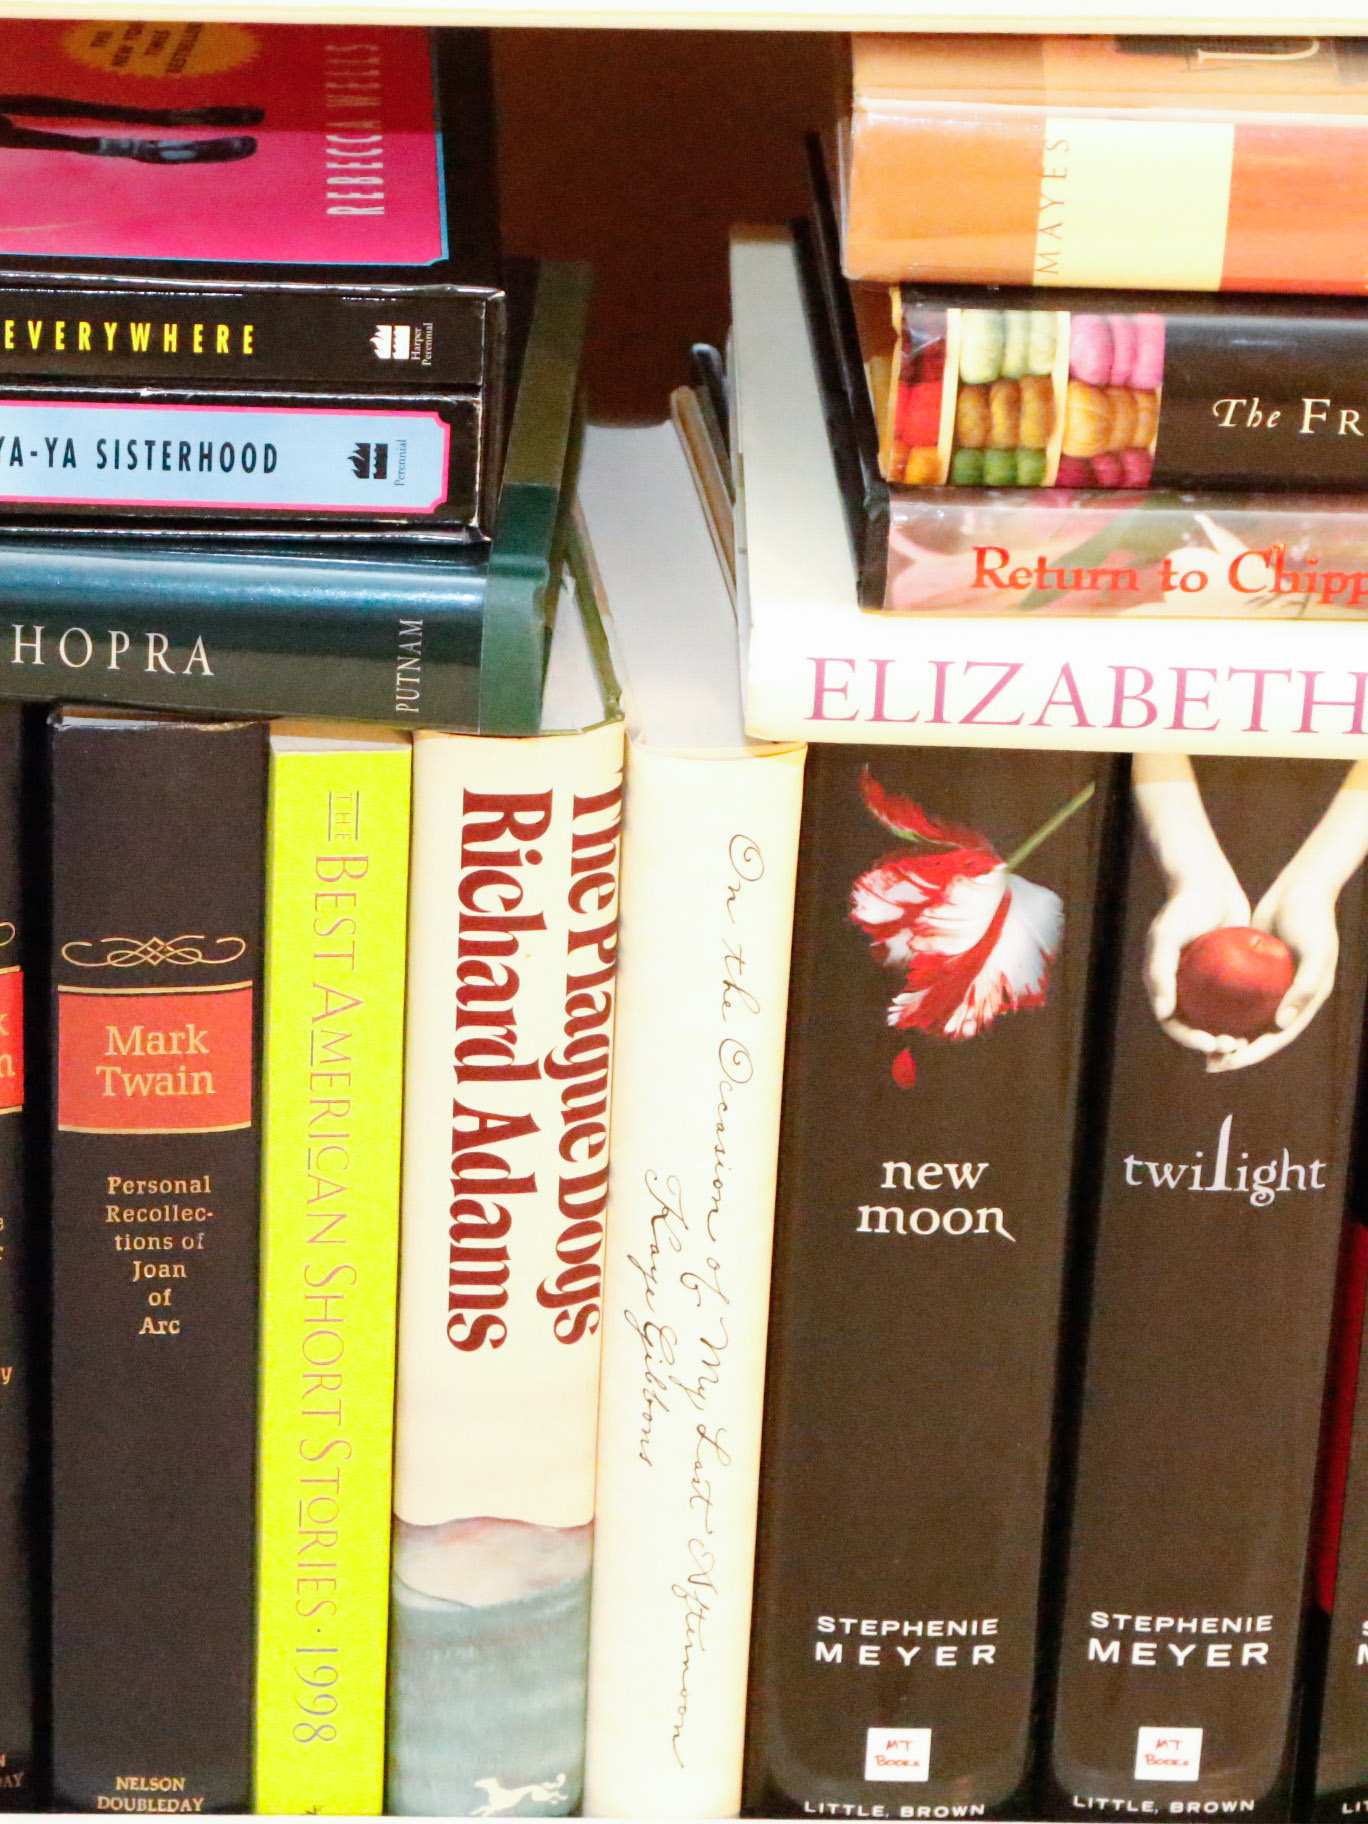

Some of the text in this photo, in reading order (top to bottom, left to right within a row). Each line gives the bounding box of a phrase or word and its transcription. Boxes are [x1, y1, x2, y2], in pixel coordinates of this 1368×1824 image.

[324, 44, 385, 215] REBECCA WELLS
[1034, 137, 1071, 276] MAYES
[4, 319, 257, 355] EVERYWHERE
[411, 327, 423, 361] Harper
[422, 322, 434, 366] Perennial
[1211, 397, 1365, 437] The FR
[95, 438, 280, 475] SISTERHOOD
[394, 439, 407, 487] Perennial
[970, 545, 1140, 593] Return
[1158, 557, 1209, 594] to
[394, 617, 424, 715] PUTNAM
[803, 656, 1368, 736] ELIZABETH
[104, 1023, 210, 1056] Mark
[542, 919, 620, 1163] Plague
[95, 1065, 216, 1097] Twain
[445, 786, 554, 1352] Richard Adams
[880, 1160, 990, 1191] new
[1122, 1113, 1328, 1207] twilight
[107, 1175, 212, 1195] Personal
[105, 1204, 214, 1224] Recollec-
[855, 1203, 1017, 1243] moon
[114, 1232, 205, 1251] tions of
[535, 1164, 610, 1346] Dogs
[132, 1260, 187, 1282] Joan
[292, 792, 369, 1744] THE BEST AMERICAN SHORT STORIES 1998
[148, 1288, 172, 1307] of
[670, 834, 765, 1768] On the Occasion of My Last Afternoon
[138, 1317, 181, 1335] Arc
[625, 1168, 689, 1468] Kaye Gibbons
[816, 1615, 1000, 1637] STEPHENIE
[1089, 1610, 1274, 1634] STEPHENIE
[814, 1642, 998, 1668] MEYER
[1087, 1637, 1271, 1668] MEYER
[115, 1775, 186, 1792] NELSON
[96, 1795, 205, 1813] DOUBLEDAY
[804, 1800, 986, 1819] LITTLE, BROWN
[1072, 1794, 1256, 1815] LITTLE, BROWN
